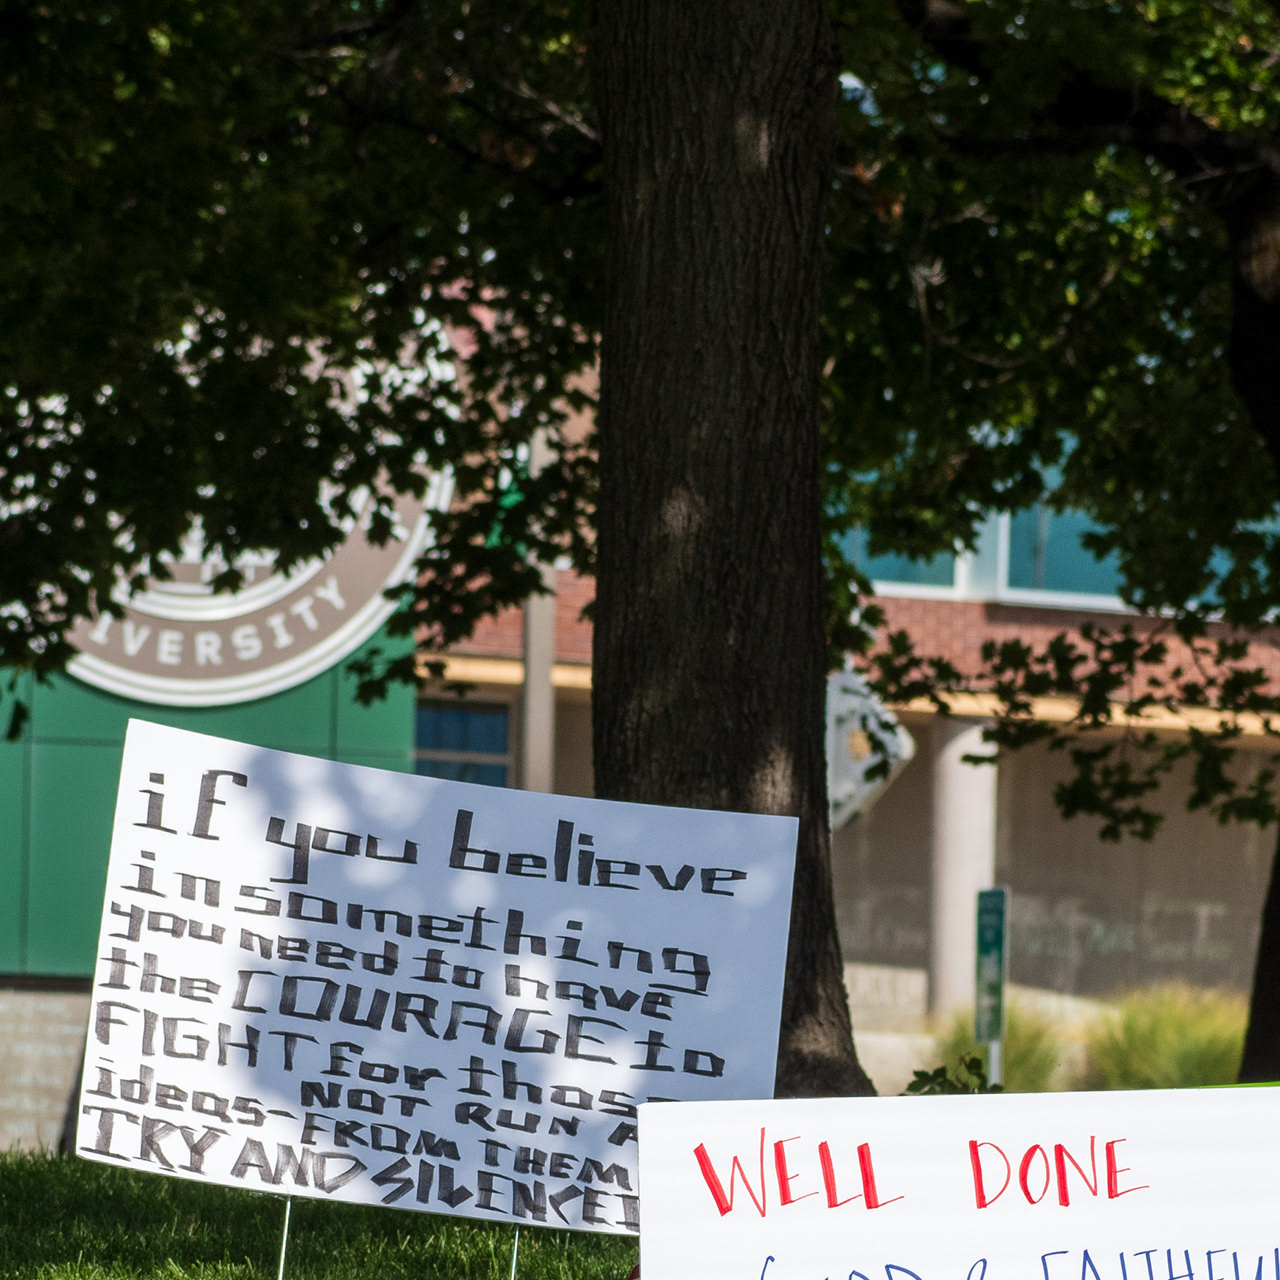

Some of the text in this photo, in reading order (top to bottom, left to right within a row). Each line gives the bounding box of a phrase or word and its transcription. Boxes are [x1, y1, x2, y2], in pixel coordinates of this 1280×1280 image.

[89, 575, 347, 666] IVERSITY
[132, 769, 748, 897] if you believe
[107, 901, 676, 1021] you need to have
[120, 850, 711, 998] in something
[94, 1000, 681, 1119] FIGHT for thos
[98, 947, 726, 1077] the COURAGE to
[80, 1104, 232, 1176] TRY
[230, 1137, 368, 1194] AND
[300, 1080, 433, 1118] NOT
[454, 1101, 586, 1141] RUN
[300, 1111, 634, 1191] FROM THEM
[692, 1126, 1151, 1218] WELL DONE
